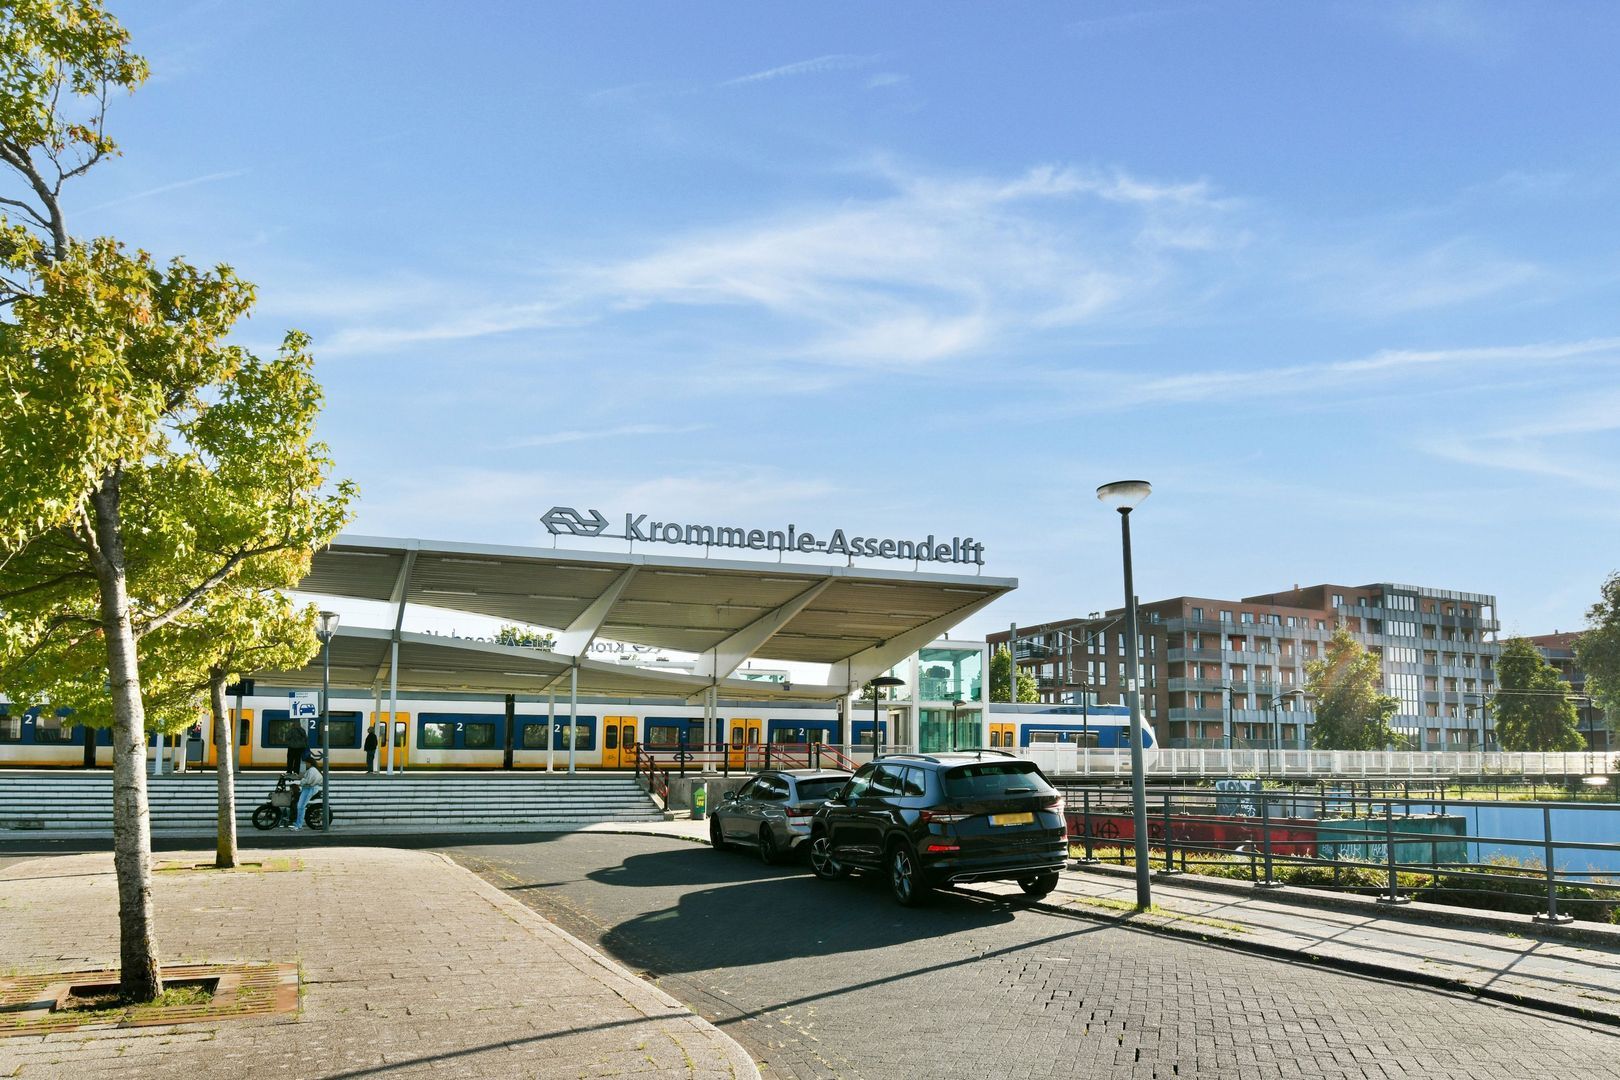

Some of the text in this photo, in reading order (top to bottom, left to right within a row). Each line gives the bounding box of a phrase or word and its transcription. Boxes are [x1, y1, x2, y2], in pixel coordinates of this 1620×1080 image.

[625, 512, 985, 565] Krommenie-Assendelft
[24, 714, 33, 725] 2
[309, 720, 316, 729] 2
[456, 722, 463, 731] 2
[554, 723, 561, 733] 2
[798, 727, 805, 736] 2
